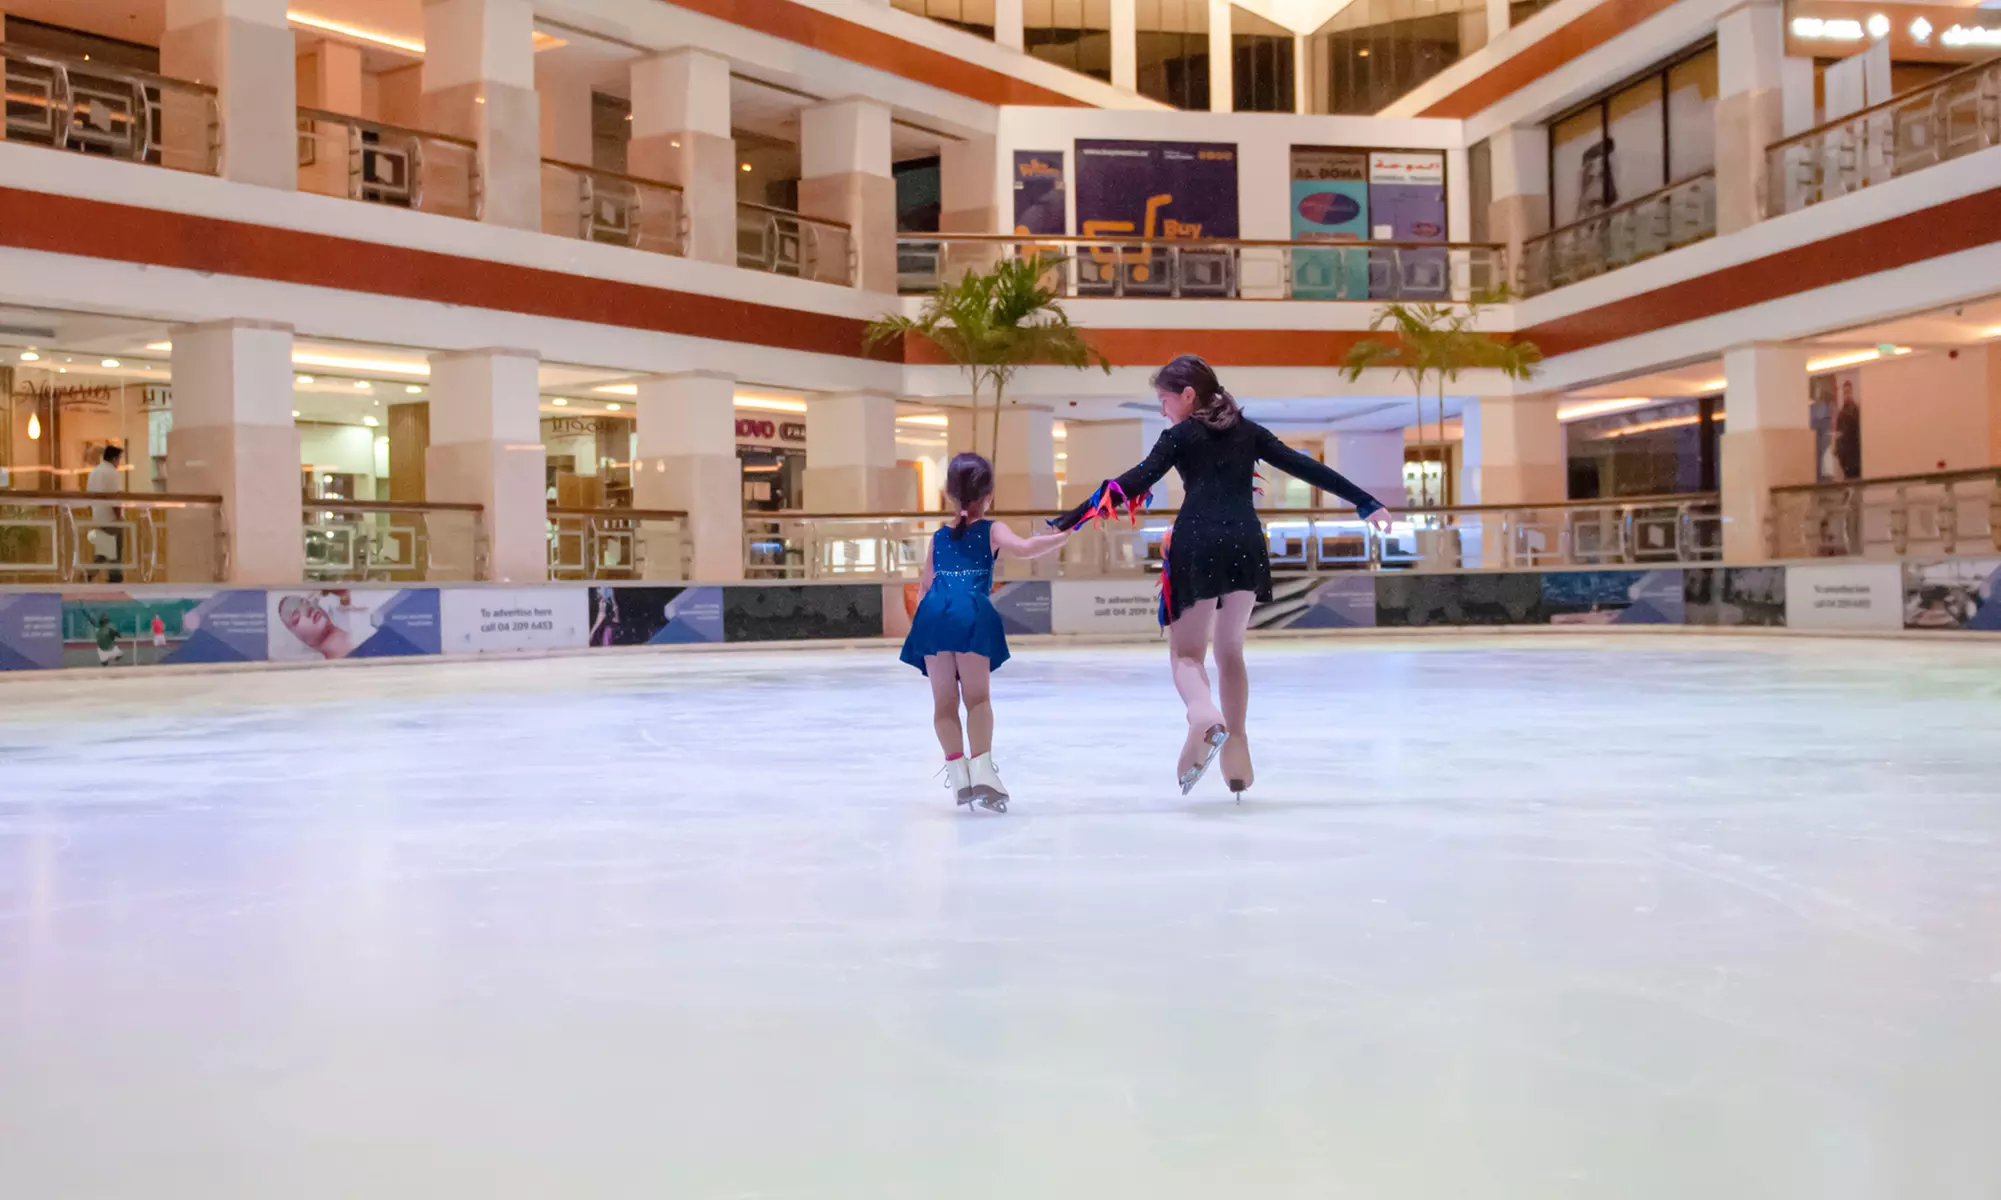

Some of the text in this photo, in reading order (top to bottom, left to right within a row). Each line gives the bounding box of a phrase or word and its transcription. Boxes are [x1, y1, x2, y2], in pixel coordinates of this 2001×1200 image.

[1164, 219, 1202, 242] Buy
[20, 380, 111, 402] Memories
[480, 607, 552, 617] To advertise here
[481, 622, 496, 632] call
[498, 622, 510, 632] 04
[512, 621, 529, 631] 209
